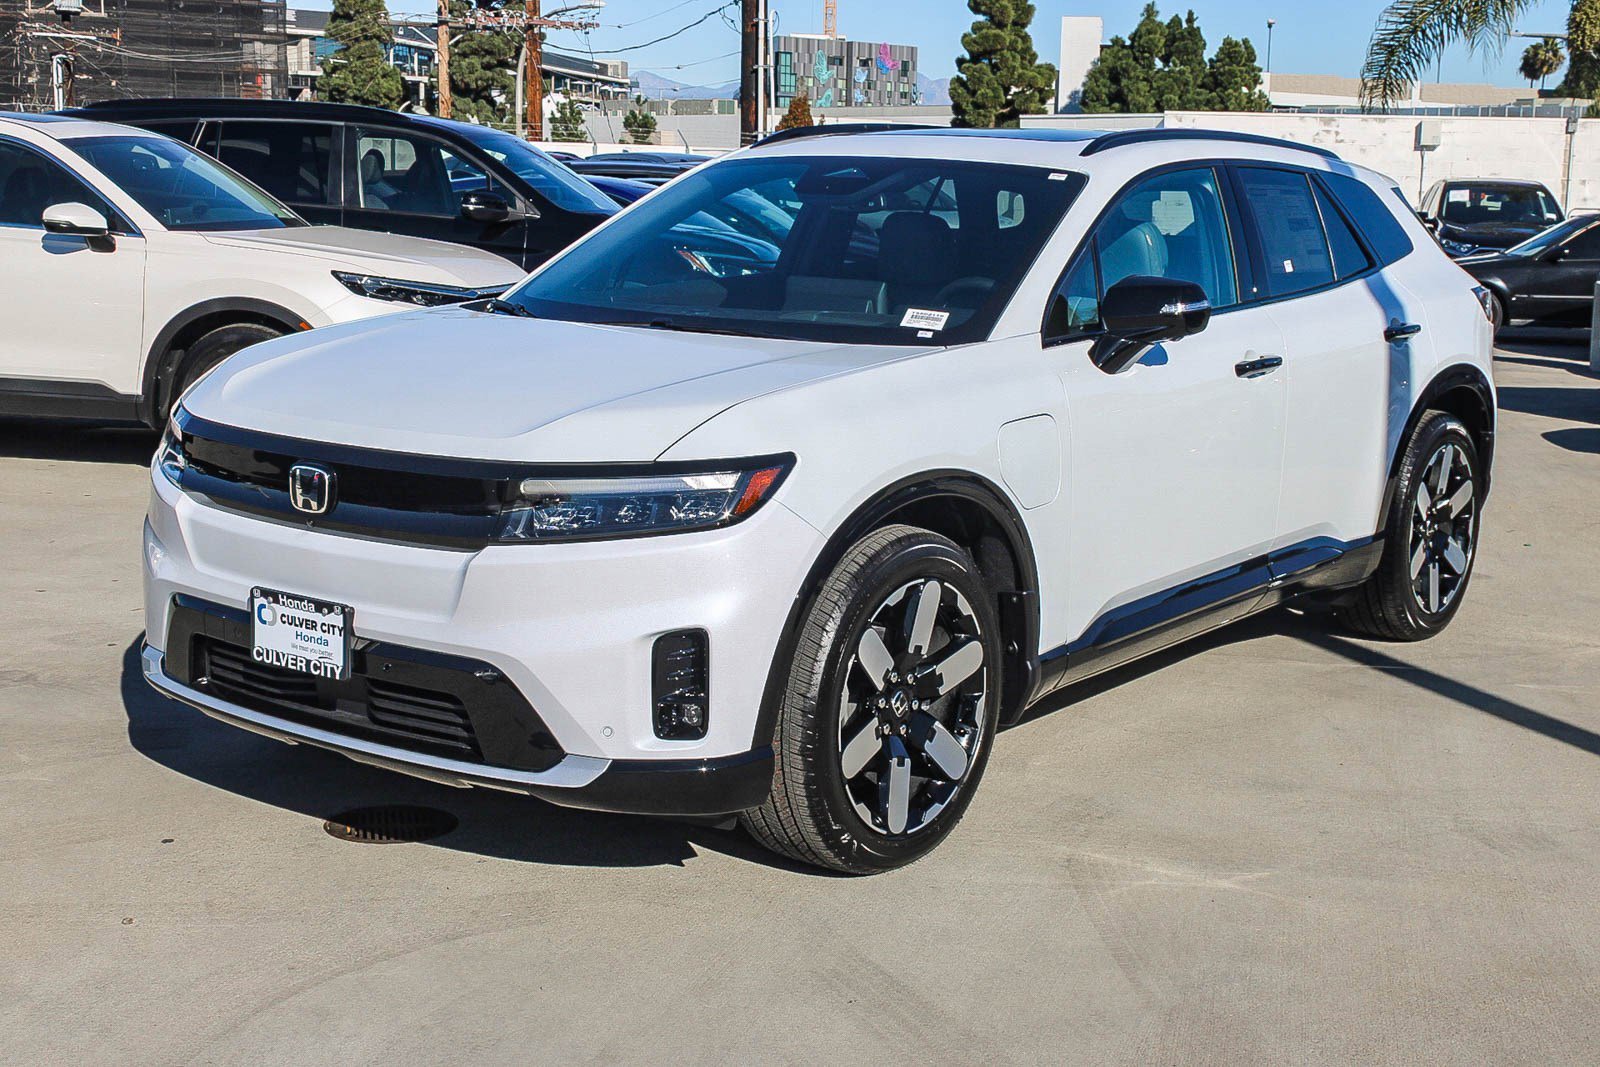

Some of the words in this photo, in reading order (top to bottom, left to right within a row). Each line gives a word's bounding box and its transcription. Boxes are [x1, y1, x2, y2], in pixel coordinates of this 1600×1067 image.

[278, 594, 316, 612] Honda
[280, 613, 318, 632] CULVER
[320, 622, 344, 637] CITY
[295, 630, 329, 647] Honda
[253, 646, 307, 673] CULVER
[310, 659, 343, 680] CITY
